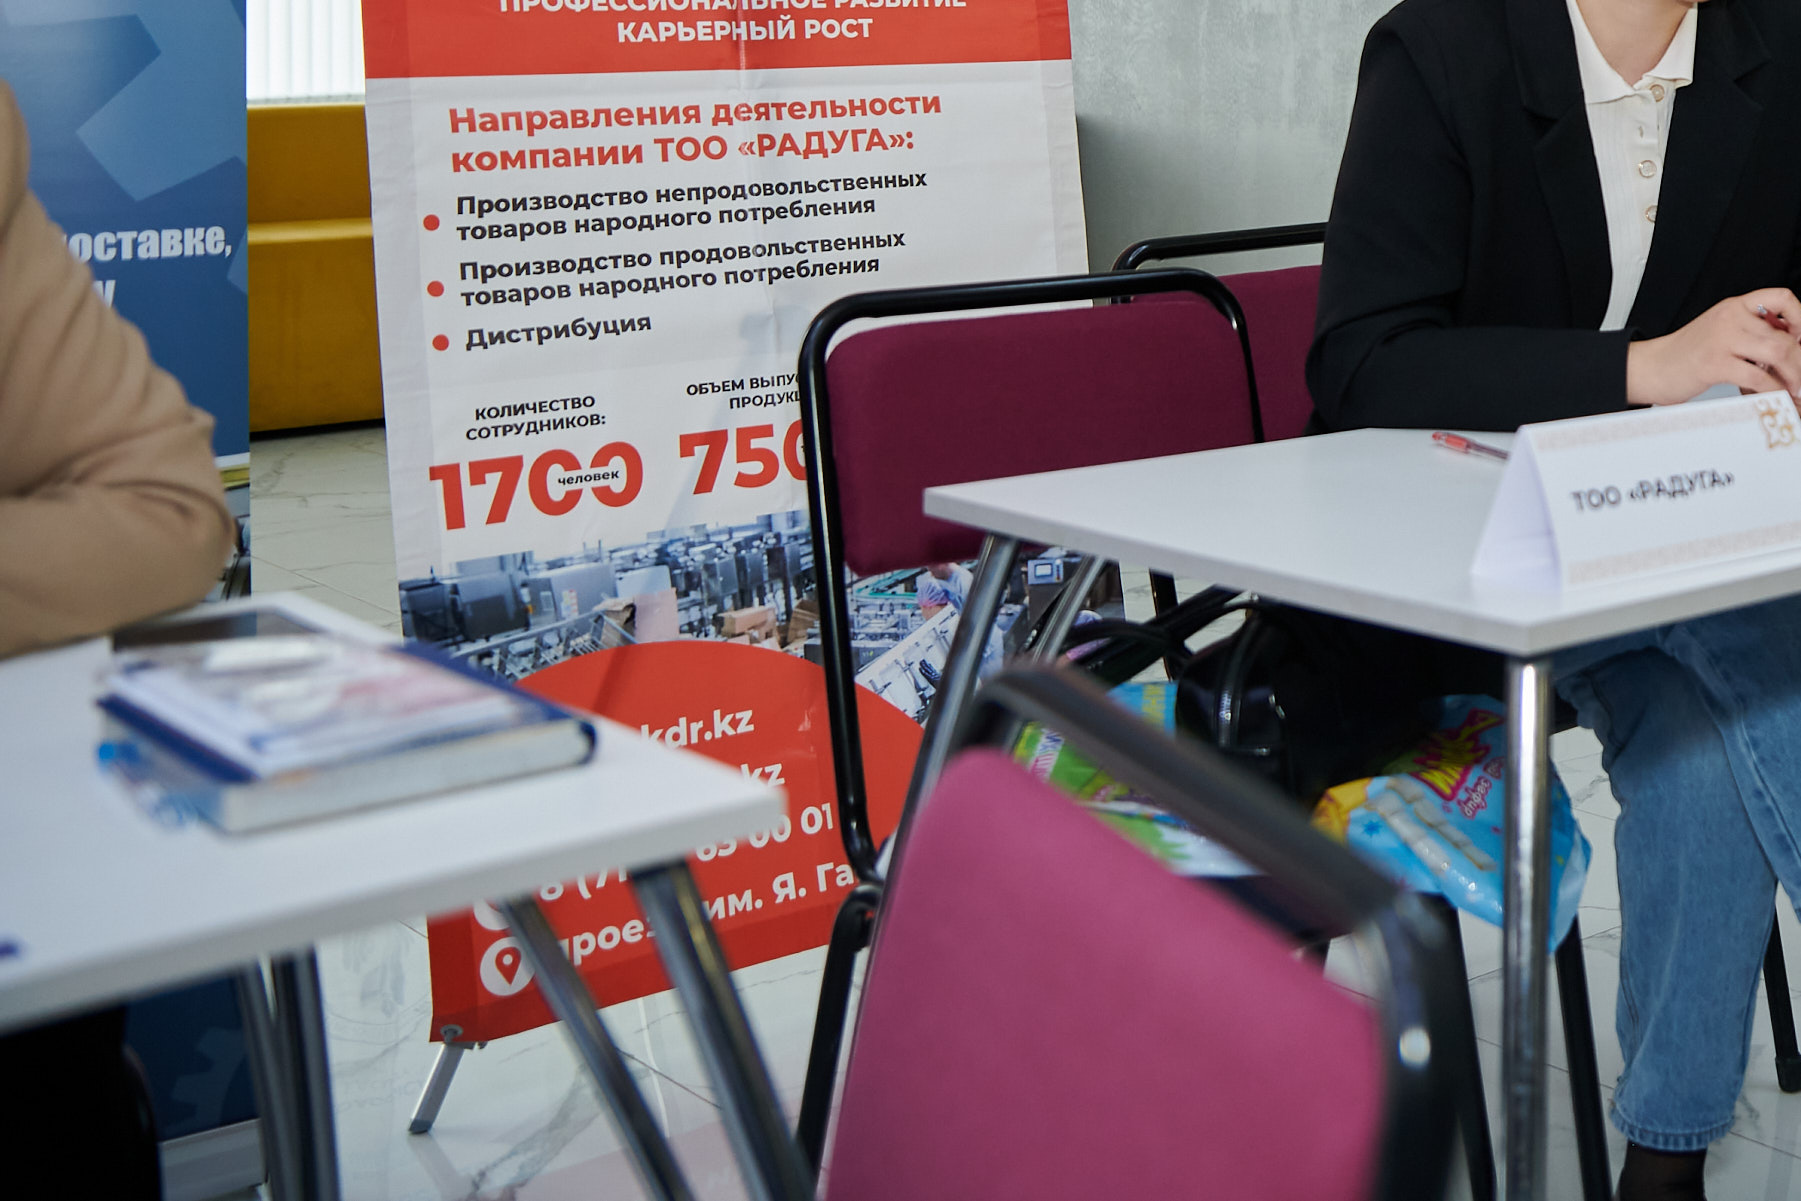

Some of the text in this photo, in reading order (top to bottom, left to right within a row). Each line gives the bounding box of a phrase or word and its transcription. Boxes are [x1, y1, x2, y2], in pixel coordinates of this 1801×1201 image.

[617, 15, 873, 43] КАРЬЕРНЫЙ РОСТ
[449, 95, 942, 137] Направления деятельности
[451, 129, 915, 173] компании ТОО «РАДУГА»:
[456, 170, 928, 219] Производство непродовольственных
[456, 197, 876, 242] товаров народного потребления
[459, 231, 906, 285] Производство продовольственных
[460, 256, 880, 308] товаров народного потребления
[465, 315, 652, 352] Дистрибуция
[687, 373, 800, 396] ОБЪЕМ ВЫПУ
[466, 414, 606, 441] СОТРУДНИКОВ:
[475, 396, 596, 421] КОЛИЧЕСТВО
[429, 441, 643, 530] 1700
[558, 469, 619, 487] человек
[1571, 469, 1735, 512] ТОО «РАДУГА»
[800, 802, 834, 835] 01
[772, 872, 807, 904] Я.
